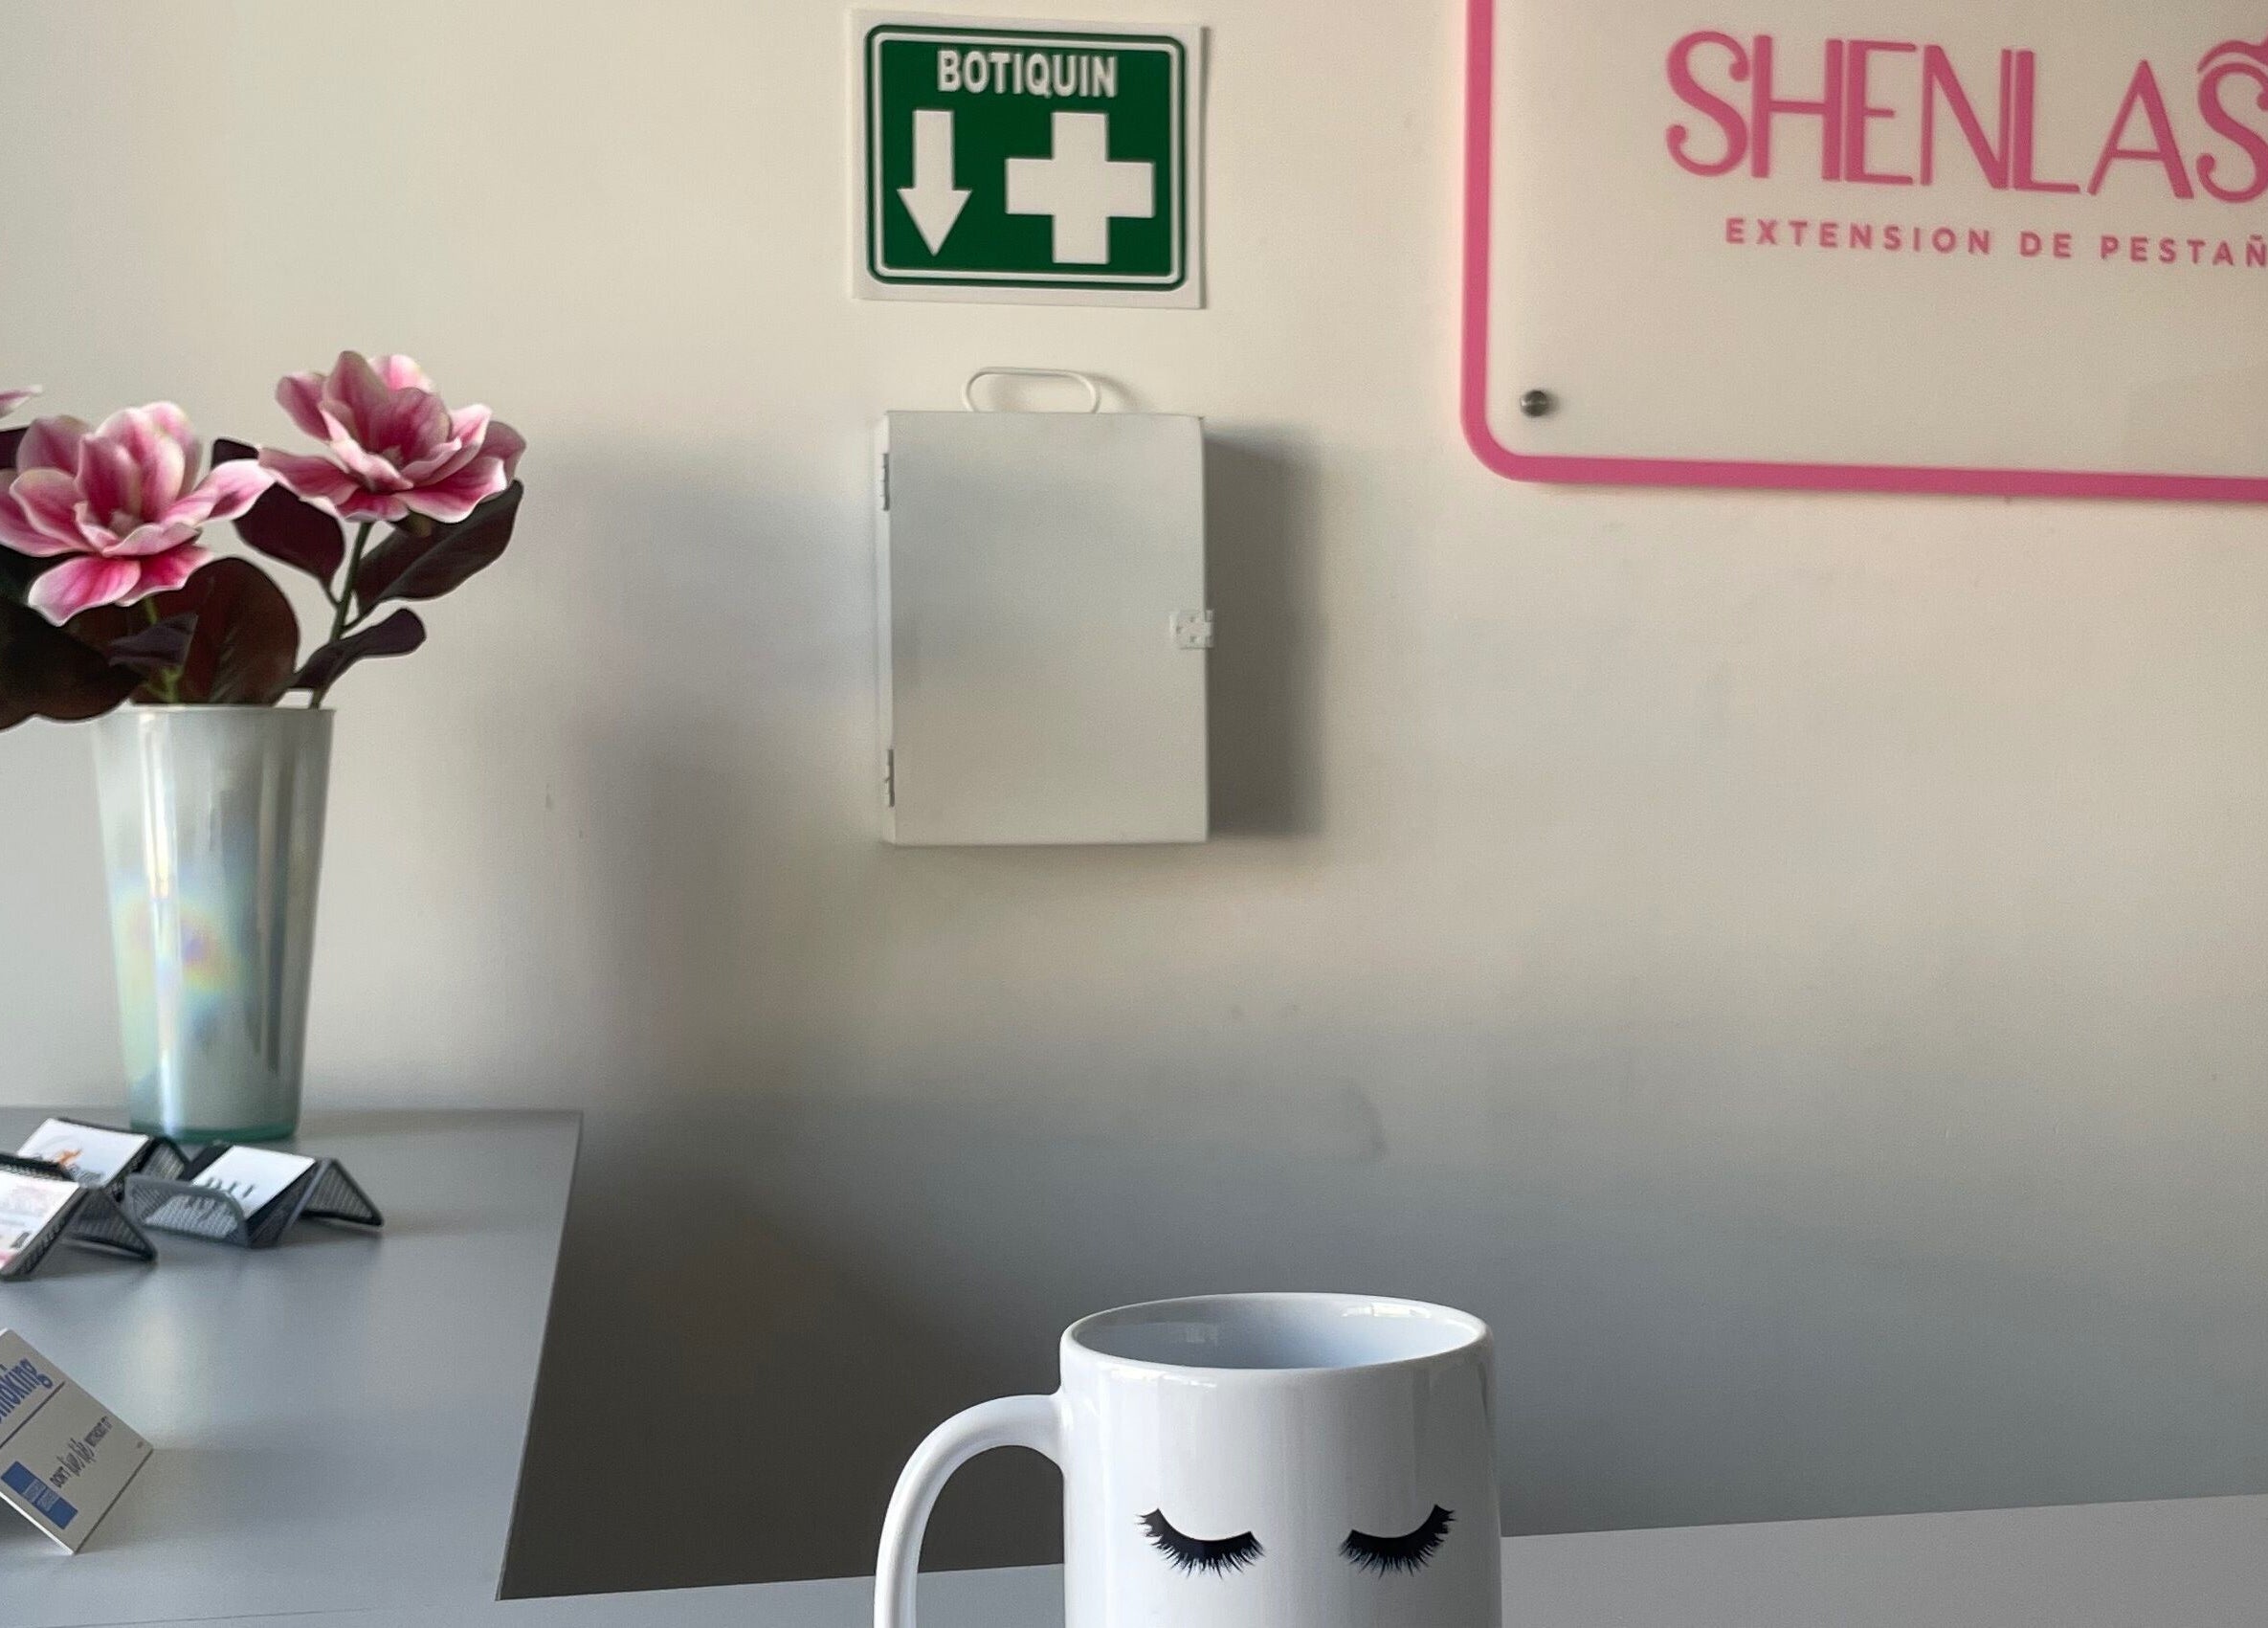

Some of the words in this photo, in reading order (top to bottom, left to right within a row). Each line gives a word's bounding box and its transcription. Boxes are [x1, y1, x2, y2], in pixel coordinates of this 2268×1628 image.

[937, 49, 1119, 99] BOTIQUIN
[1725, 217, 1991, 254] EXTENSION
[2019, 232, 2072, 259] DE
